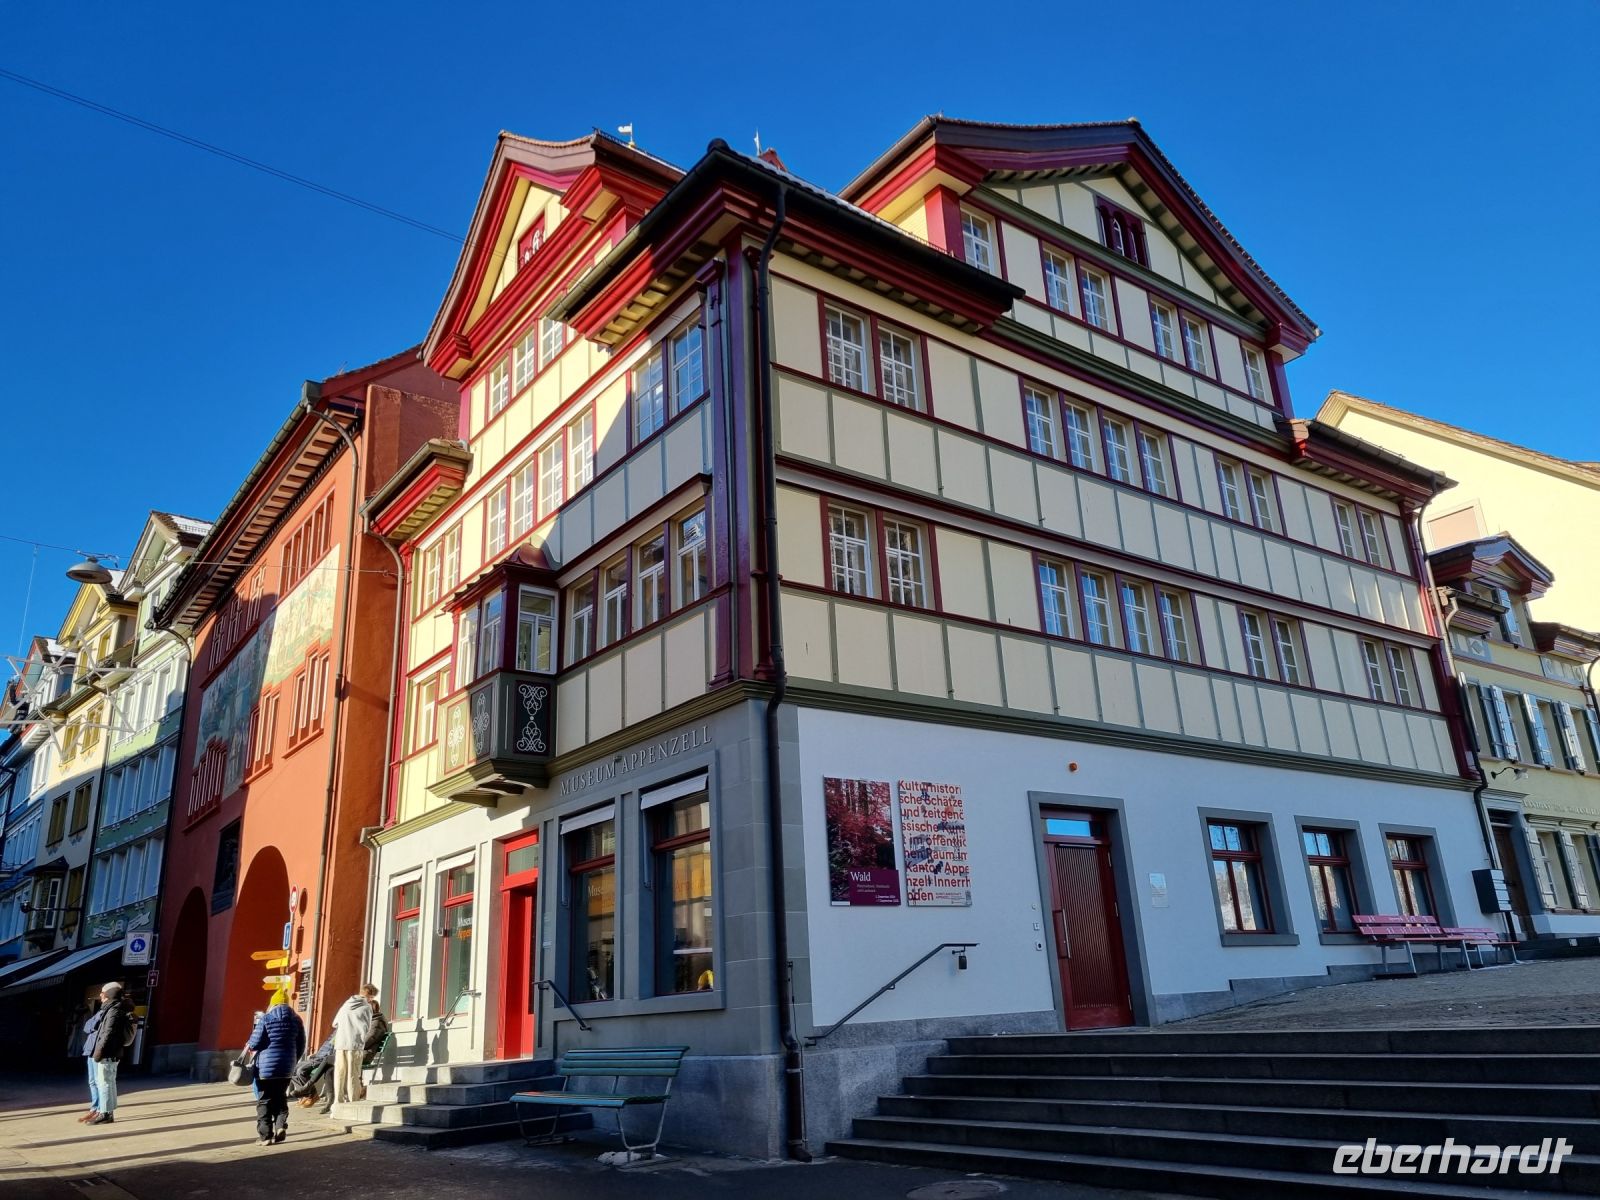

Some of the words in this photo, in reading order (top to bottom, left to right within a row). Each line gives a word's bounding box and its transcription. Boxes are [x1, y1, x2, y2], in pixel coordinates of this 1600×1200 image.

[560, 760, 617, 796] MUSEUM
[621, 725, 712, 774] APPENZELL
[899, 793, 922, 804] sche
[900, 806, 920, 818] und
[901, 820, 938, 832] ssische
[926, 847, 954, 860] Raum
[850, 871, 871, 882] Wald
[907, 889, 934, 901] oden
